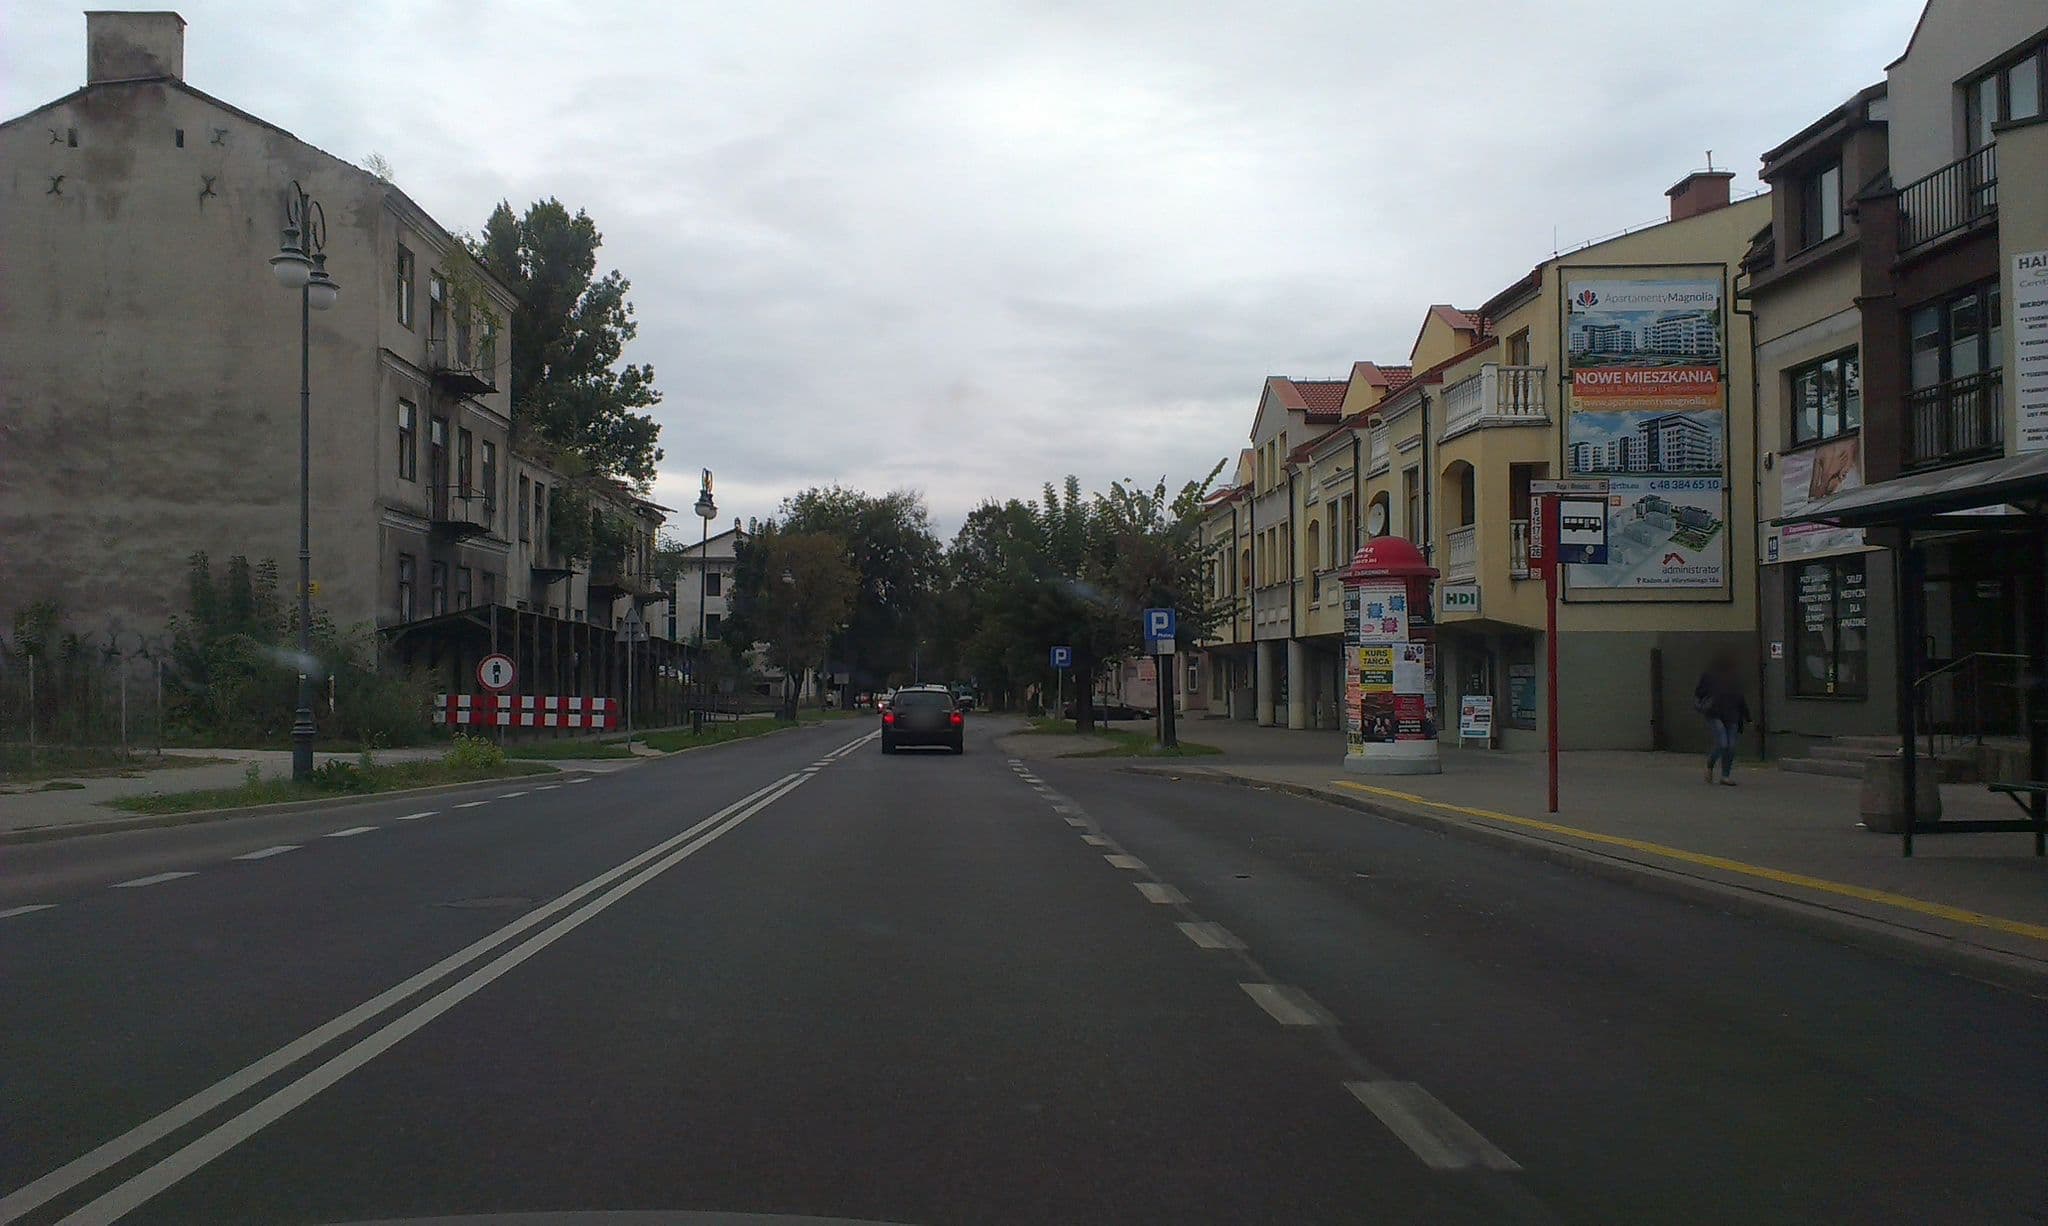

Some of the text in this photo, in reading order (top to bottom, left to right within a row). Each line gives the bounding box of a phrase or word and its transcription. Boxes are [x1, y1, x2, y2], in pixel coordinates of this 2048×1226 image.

[1574, 370, 1714, 384] NOWE MIESZKANIA
[1657, 480, 1670, 490] 48
[1692, 480, 1705, 489] 65
[1708, 479, 1719, 489] 10
[1662, 565, 1720, 575] administrator
[1446, 593, 1475, 605] HDI
[1849, 603, 1861, 613] DLA
[1152, 612, 1169, 636] P
[1840, 617, 1867, 627] AMAZONE
[1056, 648, 1067, 664] P
[1364, 649, 1388, 657] KURS
